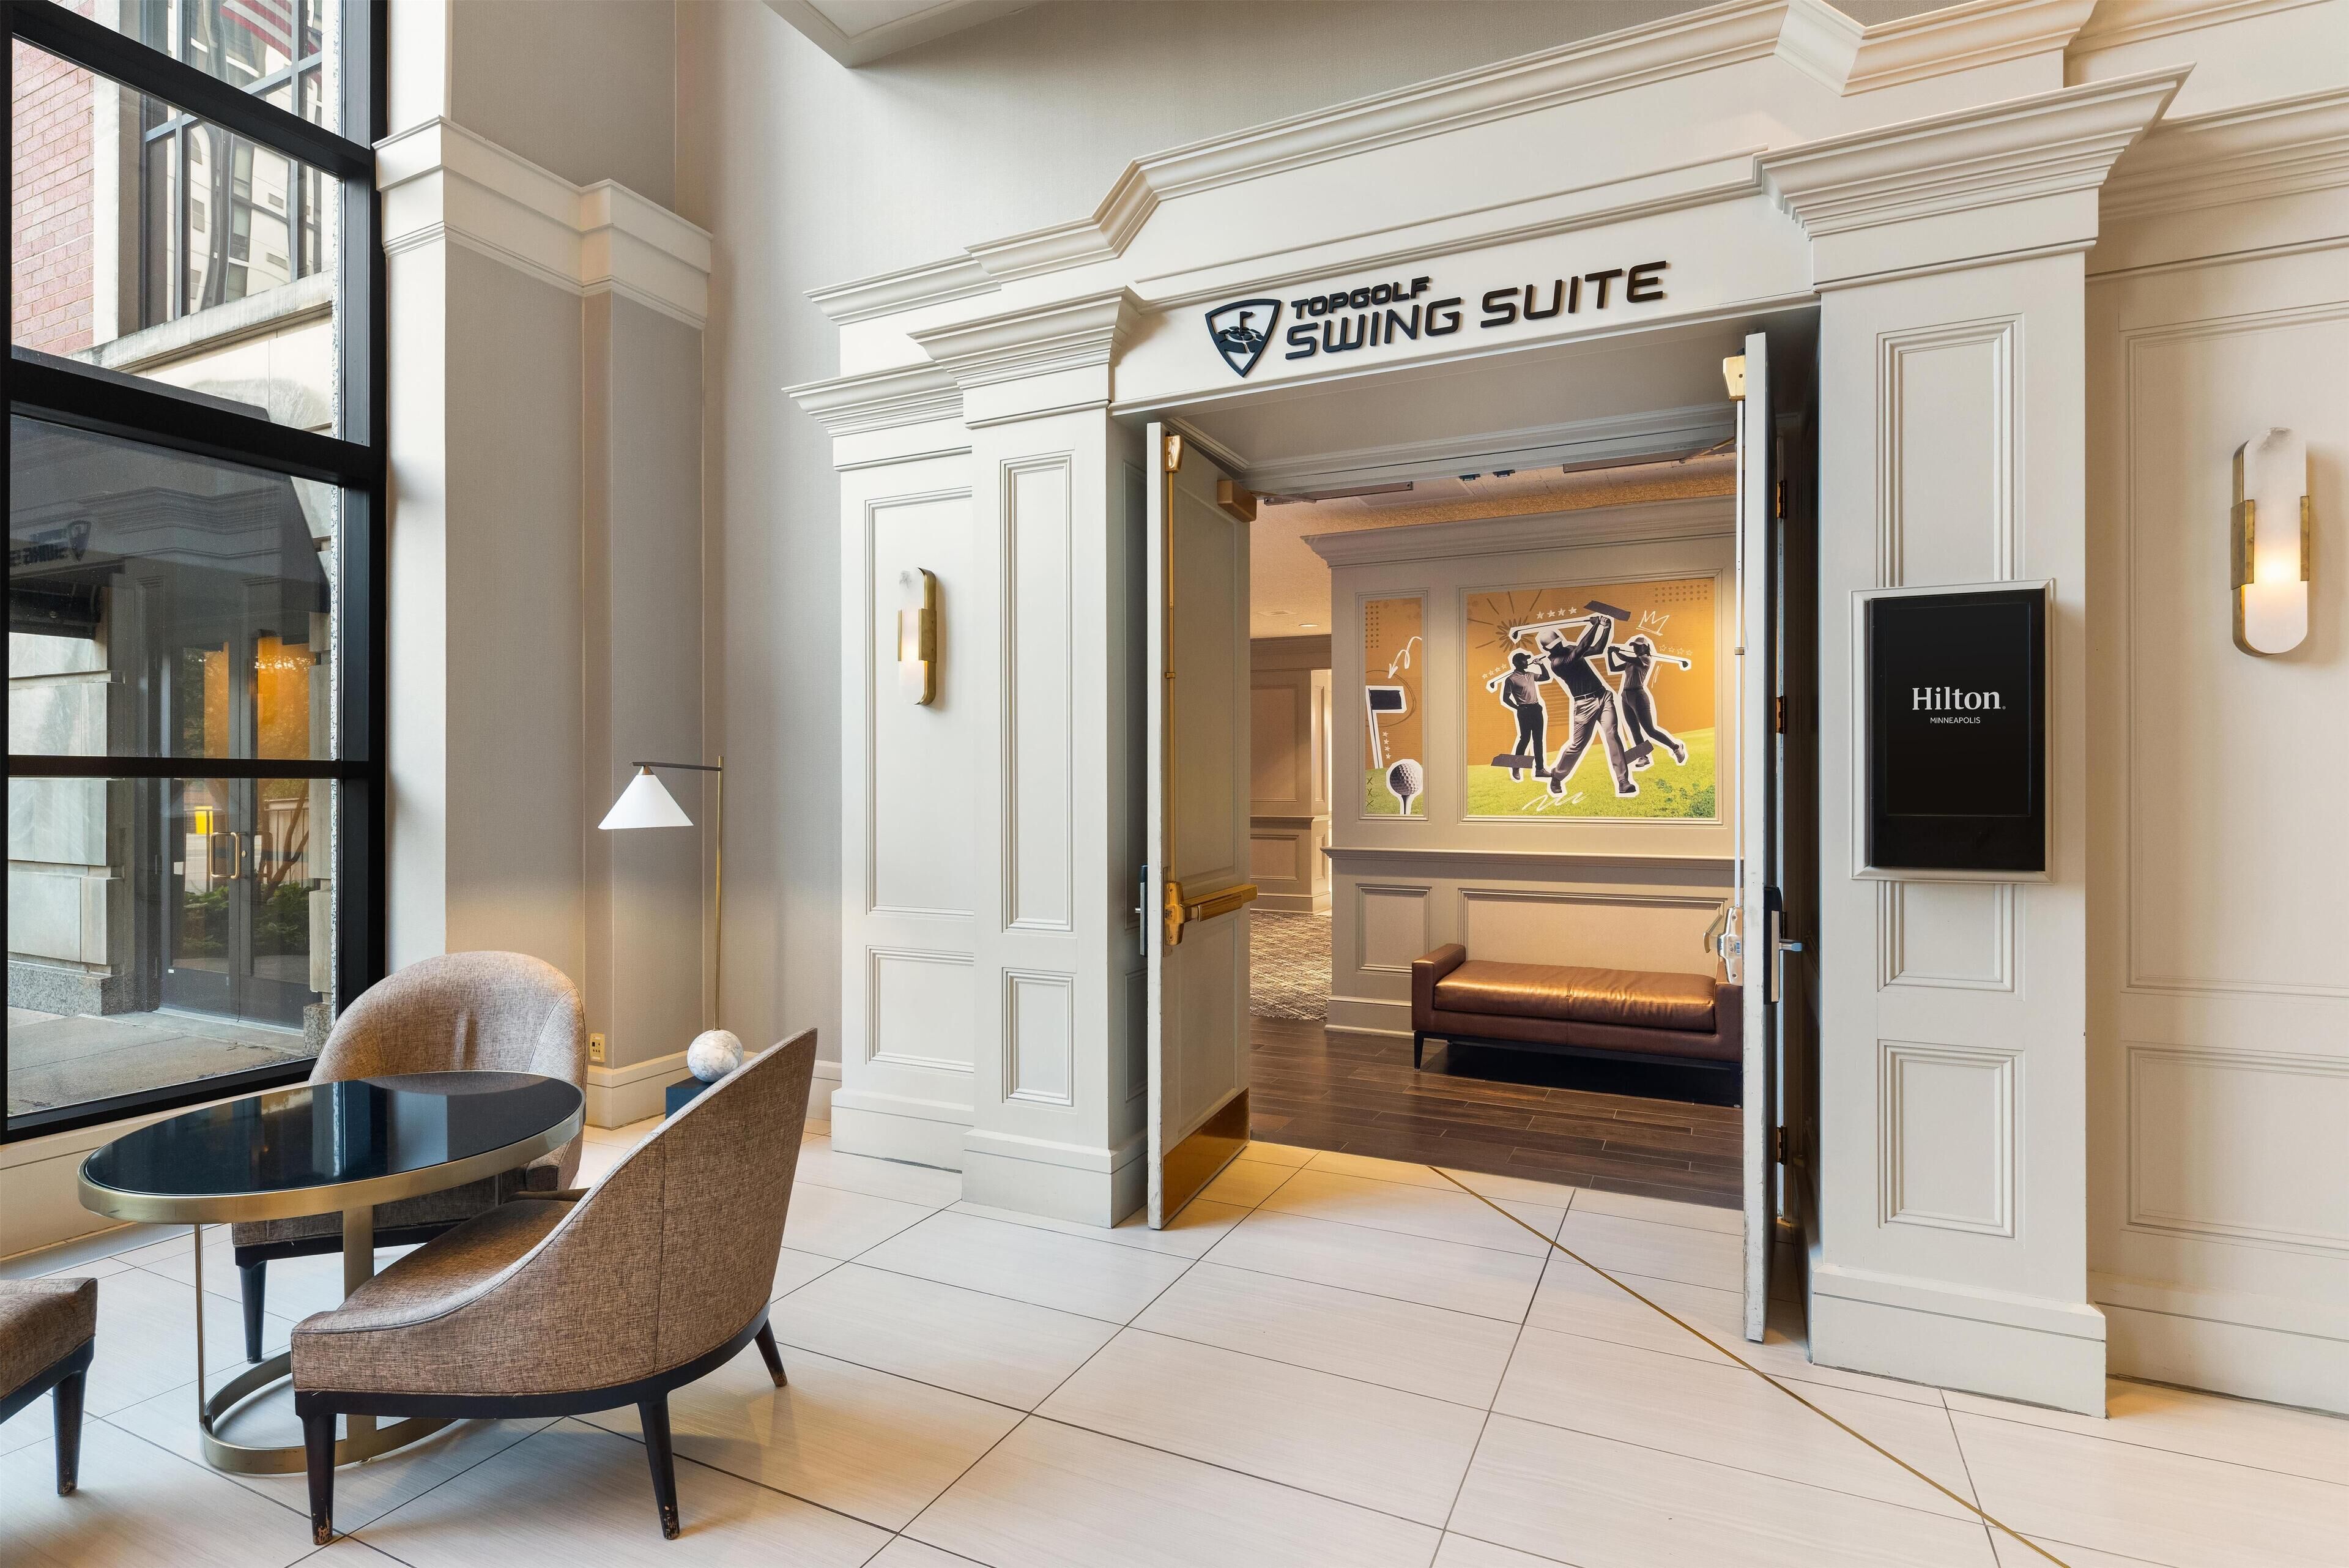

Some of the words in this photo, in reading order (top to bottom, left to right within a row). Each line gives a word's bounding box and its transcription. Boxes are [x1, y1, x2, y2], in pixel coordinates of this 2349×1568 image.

[1285, 297, 1462, 360] SWING
[1480, 260, 1668, 329] SUITE
[1291, 276, 1430, 319] TOPGOLF
[1912, 686, 2002, 710] Hilton
